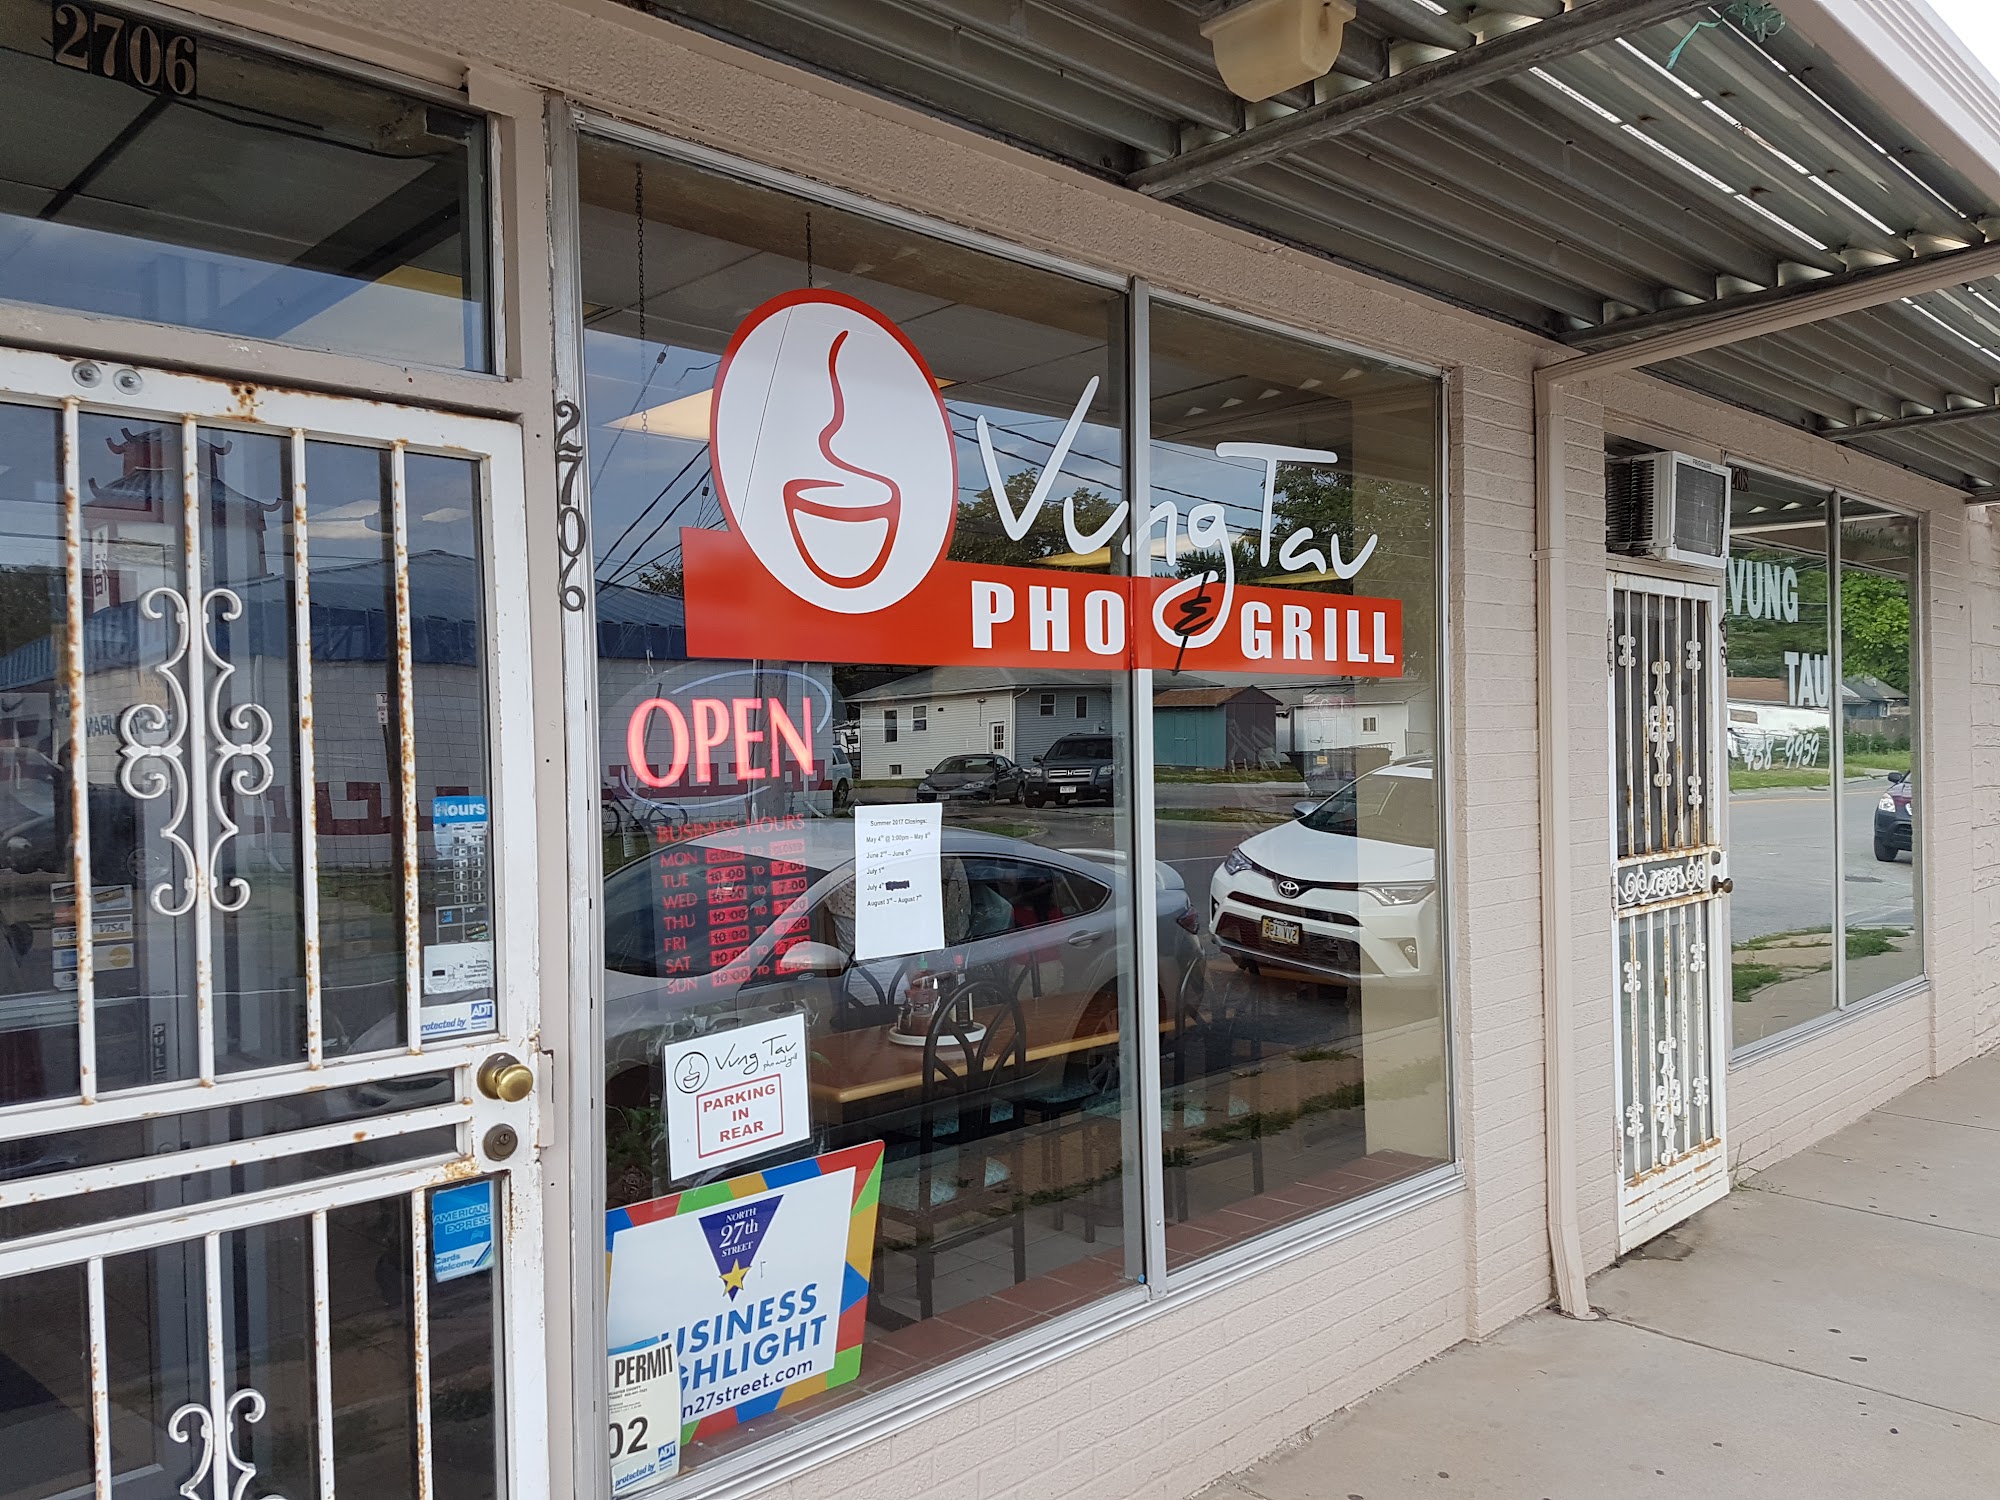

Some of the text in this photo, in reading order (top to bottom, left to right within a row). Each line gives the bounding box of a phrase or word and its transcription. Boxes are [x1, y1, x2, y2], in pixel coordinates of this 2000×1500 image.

[55, 3, 196, 95] 2706
[556, 400, 586, 612] 2706
[976, 375, 1235, 649] Vung
[1727, 557, 1799, 623] VUNG
[971, 580, 1125, 655] PHO
[1240, 601, 1395, 664] GRILL
[1784, 651, 1829, 708] TAU
[626, 696, 814, 788] OPEN
[435, 803, 486, 817] Hours
[656, 813, 805, 843] BUSINESS HOURS
[660, 852, 697, 867] MON
[661, 873, 689, 888] TUE
[752, 865, 765, 875] TO
[662, 893, 698, 909] WED
[753, 886, 766, 895] TO
[867, 899, 885, 907] August
[898, 895, 915, 903] August
[99, 923, 125, 933] VISA
[664, 915, 696, 931] THU
[754, 905, 767, 915] TO
[664, 936, 686, 952] FRI
[755, 925, 767, 935] TO
[665, 956, 691, 974] SAT
[756, 945, 768, 955] TO
[667, 978, 698, 994] SUN
[757, 966, 770, 975] TO
[471, 1003, 492, 1019] ADT
[421, 1019, 455, 1032] rotected
[456, 1018, 467, 1028] by
[715, 1043, 759, 1075] Vung
[703, 1083, 776, 1113] PARKING
[732, 1107, 749, 1121] IN
[720, 1121, 764, 1142] REAR
[434, 1203, 487, 1225] AMERICAN
[446, 1215, 491, 1233] EXPRESS
[725, 1207, 757, 1223] NORTH
[719, 1219, 759, 1248] 27th
[435, 1253, 461, 1265] Cards
[721, 1241, 754, 1257] STREET
[435, 1259, 475, 1273] Welcome
[614, 1343, 674, 1388] PERMIT
[658, 1443, 676, 1459] ADT
[615, 1466, 647, 1488] protected
[646, 1462, 656, 1474] by
